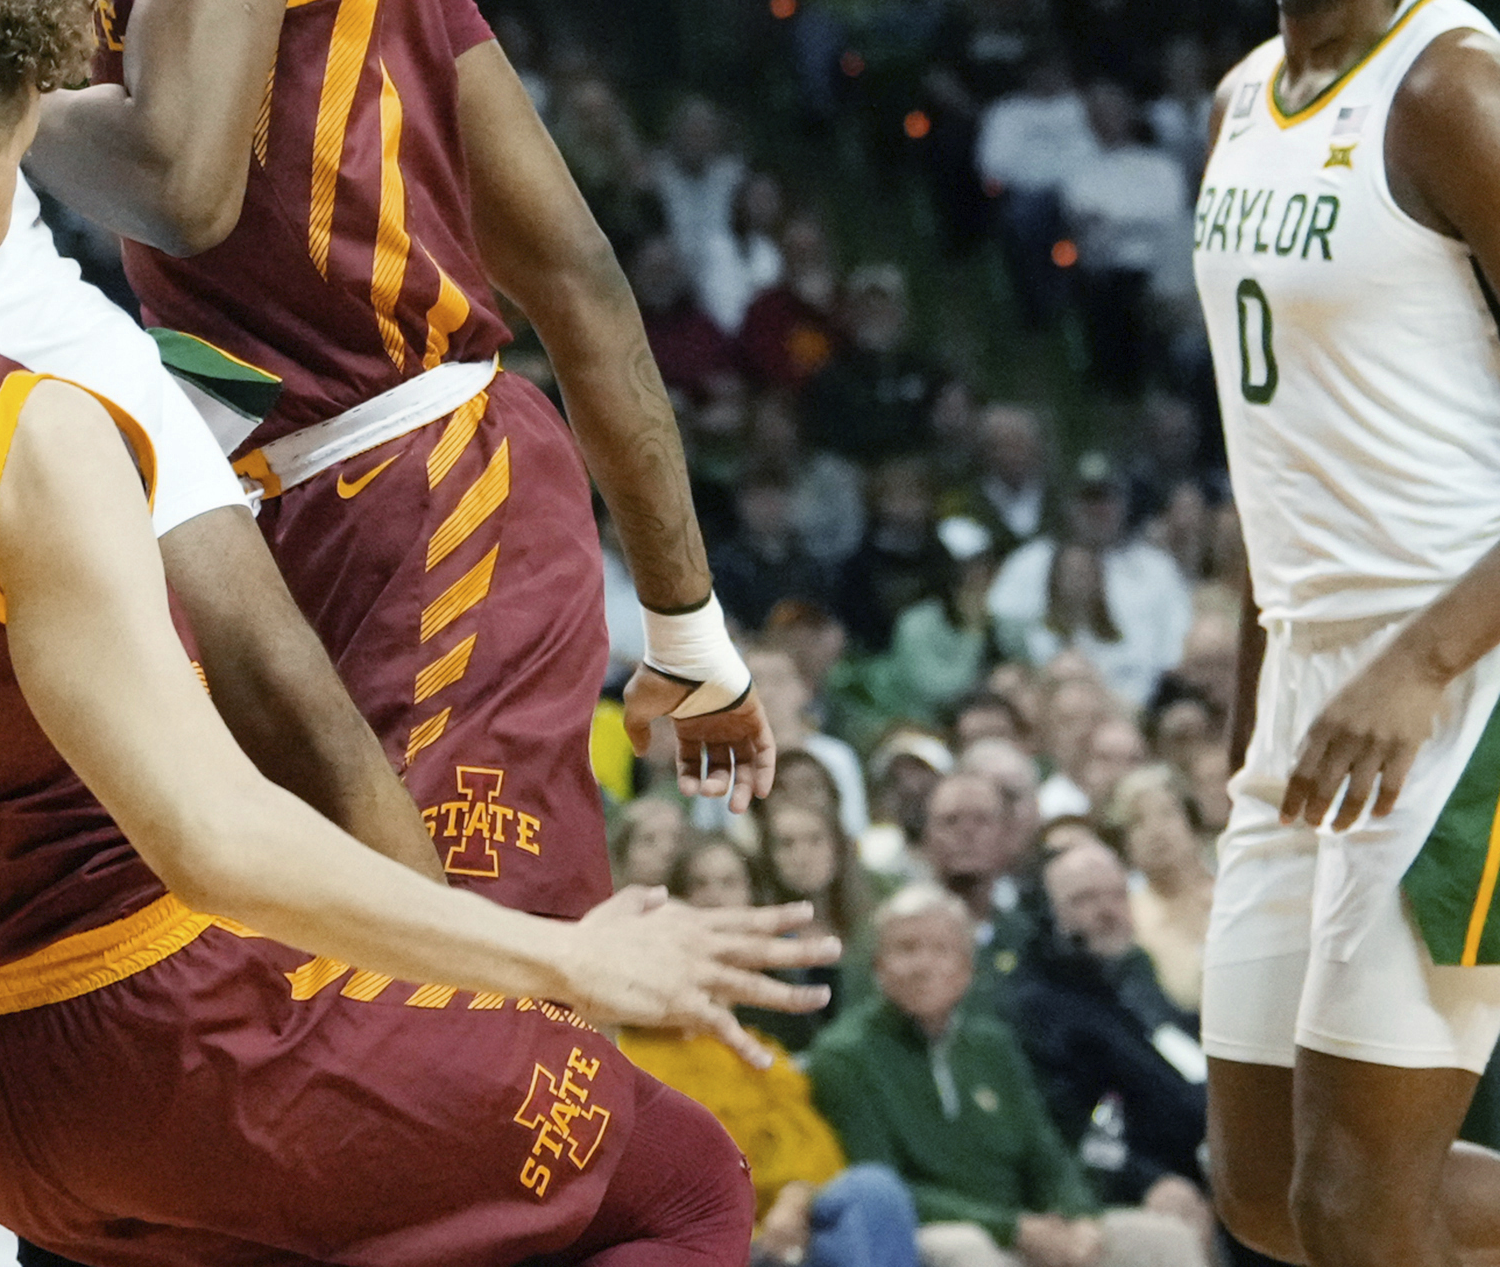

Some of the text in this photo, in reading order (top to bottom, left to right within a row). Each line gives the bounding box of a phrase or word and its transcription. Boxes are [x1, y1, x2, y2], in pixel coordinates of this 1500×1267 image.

[1195, 187, 1340, 261] BAYLOR
[1236, 279, 1279, 405] 0
[422, 801, 541, 855] STATE
[520, 1046, 602, 1198] STATE
